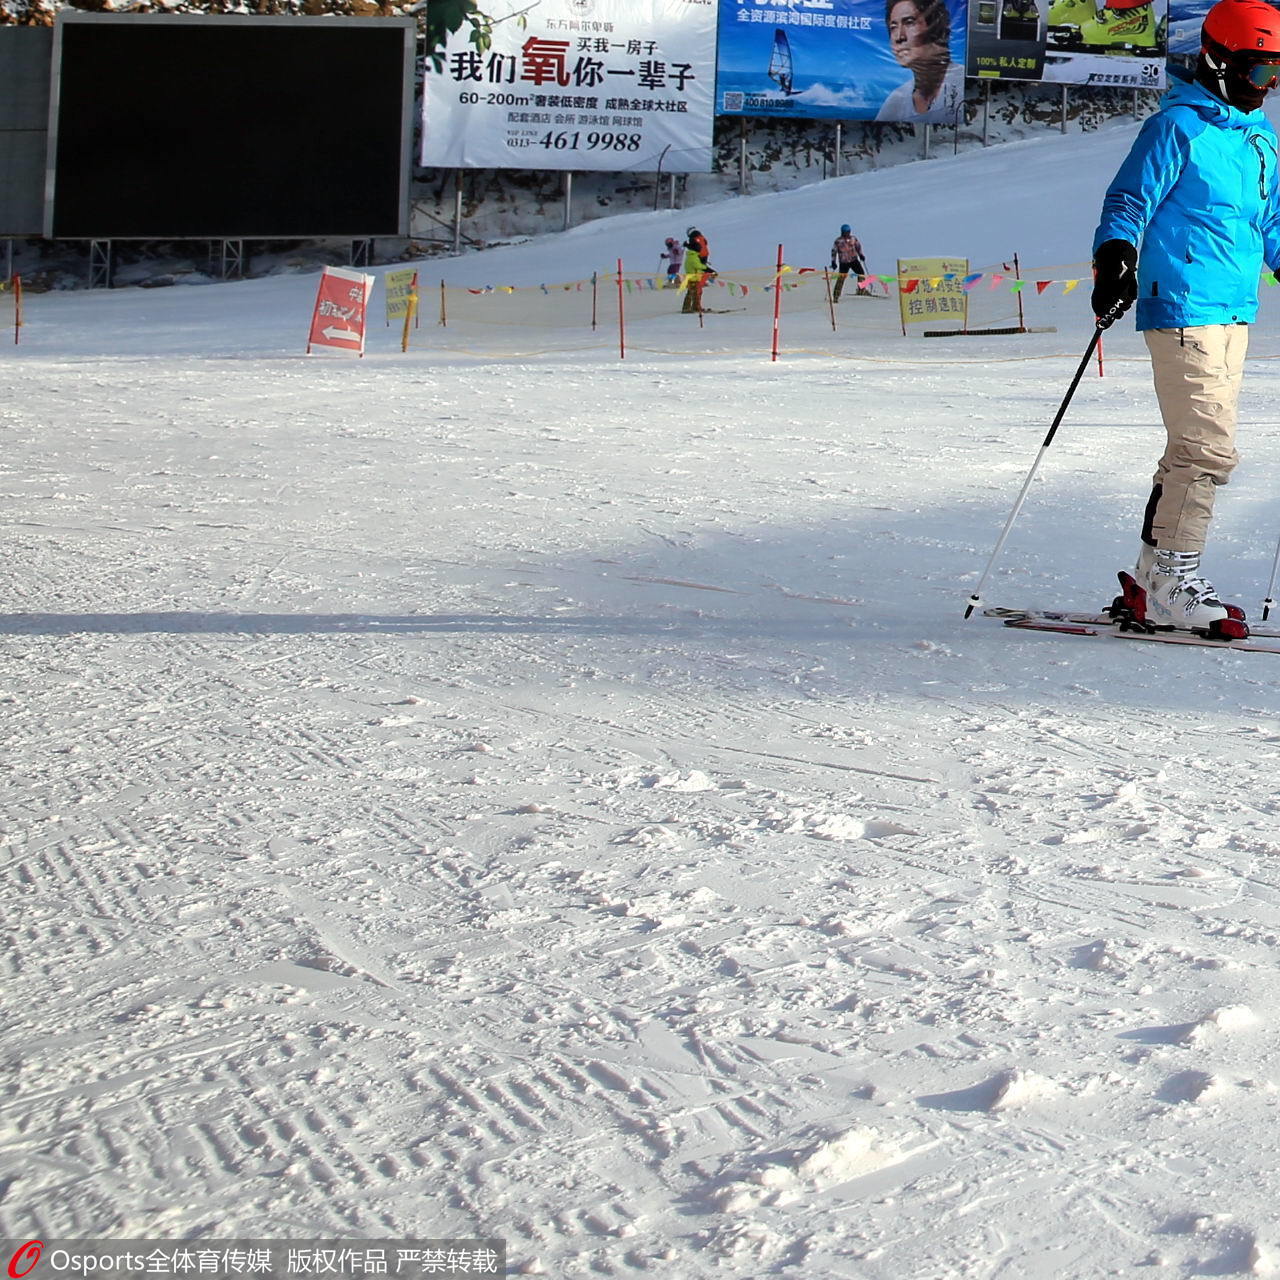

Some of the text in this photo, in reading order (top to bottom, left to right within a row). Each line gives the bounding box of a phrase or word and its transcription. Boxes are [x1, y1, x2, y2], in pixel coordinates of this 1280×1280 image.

[576, 37, 659, 56] 买我一房子
[450, 35, 695, 92] 我们氧你一辈子
[976, 56, 1036, 69] 100% 私人定制
[1141, 64, 1160, 78] 90
[605, 97, 688, 113] 成熟全球大社区
[507, 111, 643, 128] 配套酒店 会所 游泳馆 网球馆
